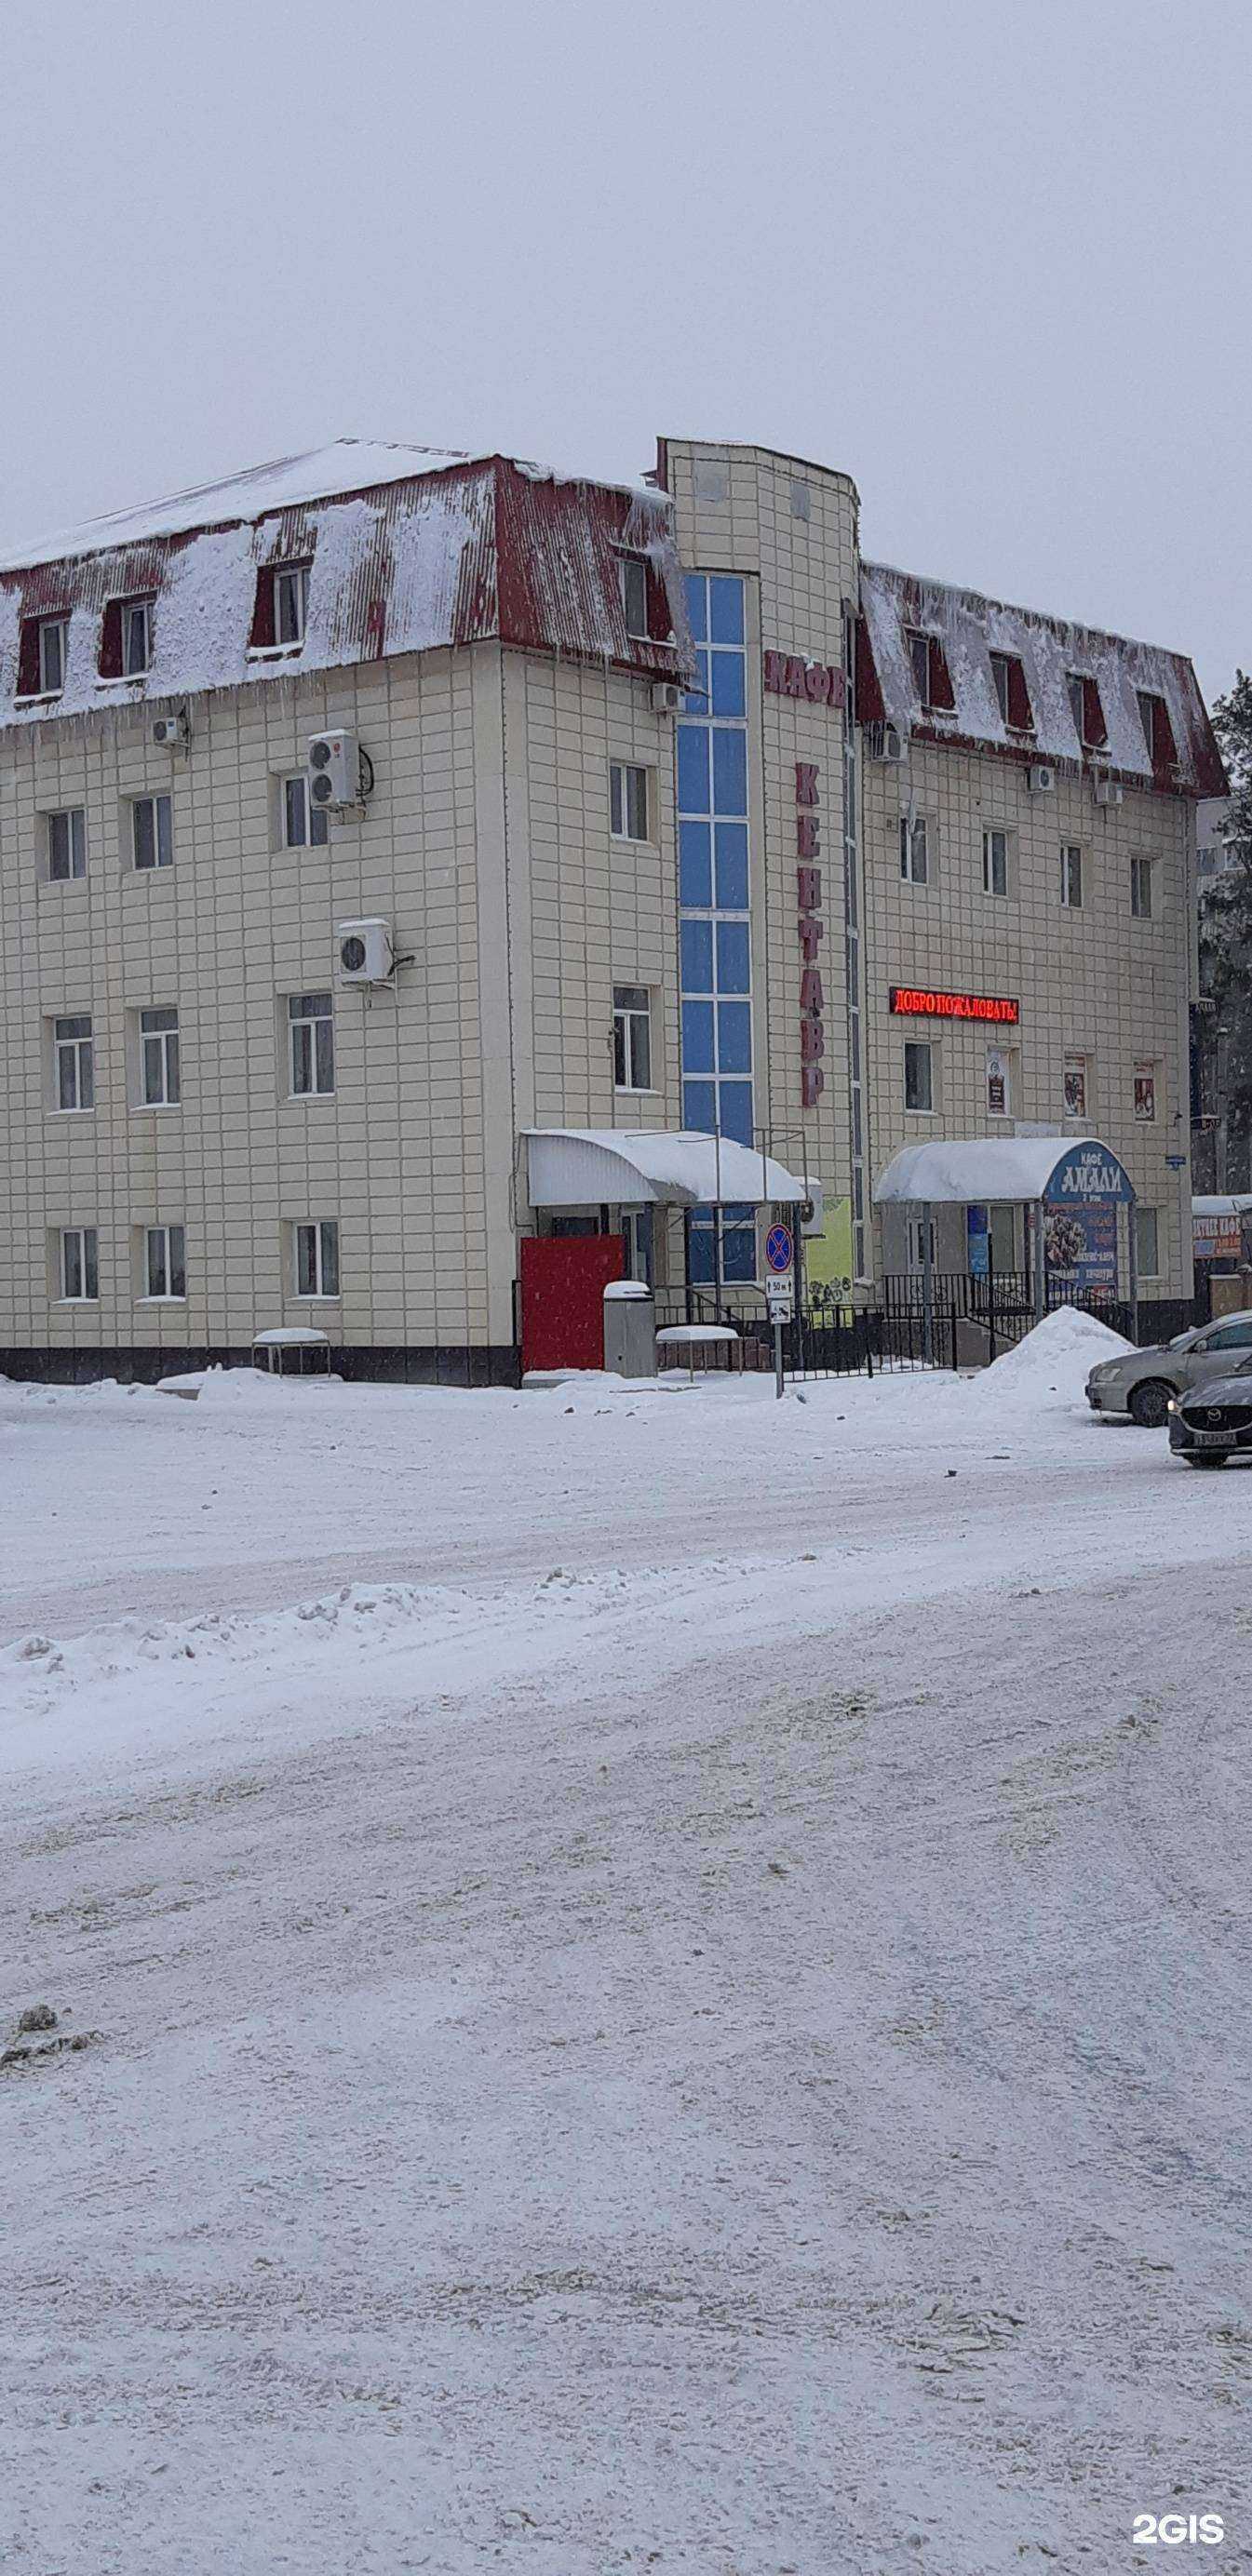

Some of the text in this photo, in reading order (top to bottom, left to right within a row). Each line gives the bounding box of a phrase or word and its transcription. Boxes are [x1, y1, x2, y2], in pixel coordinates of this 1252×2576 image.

[763, 650, 846, 707] КАФЕ
[796, 762, 825, 1108] КЕНТАВР
[895, 989, 1017, 1020] ДОБРО ПОЖАЛОВАТЬ!
[1081, 1152, 1103, 1165] КАФЕ
[773, 1281, 781, 1291] 50
